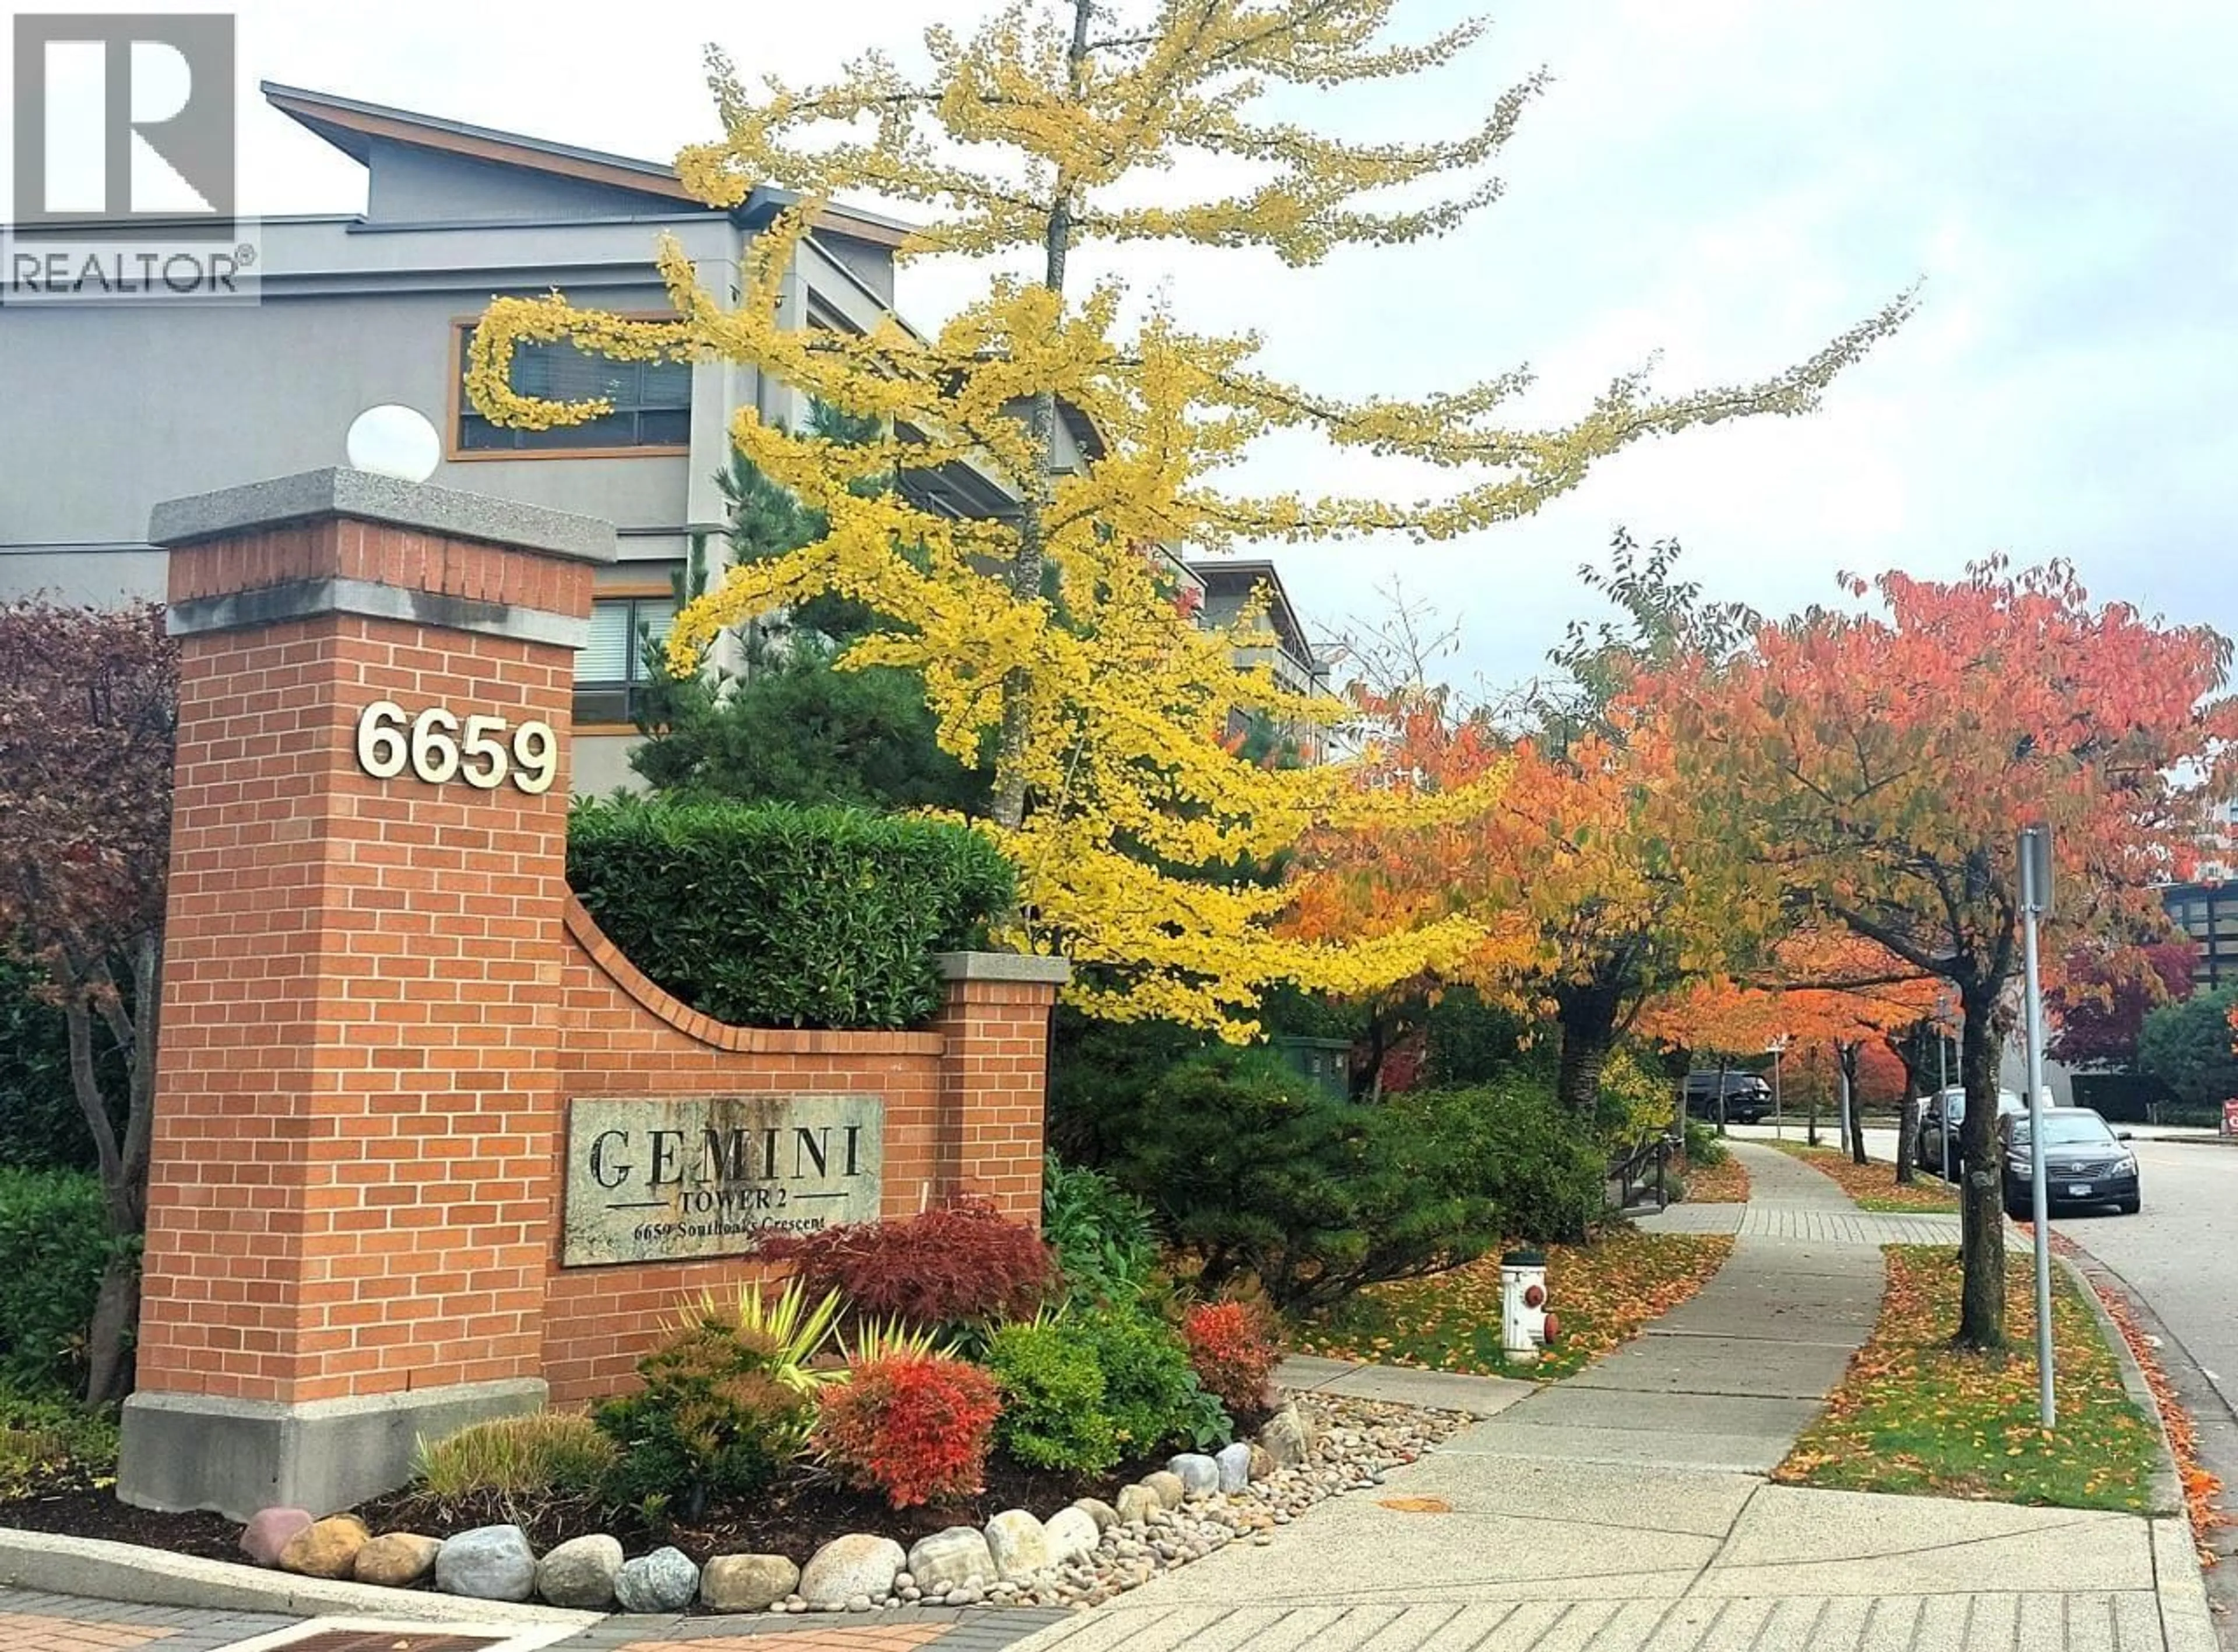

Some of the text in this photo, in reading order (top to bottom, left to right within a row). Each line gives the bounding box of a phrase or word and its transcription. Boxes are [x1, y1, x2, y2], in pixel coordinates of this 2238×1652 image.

[357, 700, 557, 794] 6659
[589, 1125, 862, 1189] GEMINI
[678, 1188, 787, 1213] TOWER 2
[634, 1223, 671, 1241] 6659
[762, 1216, 825, 1232] Crescent
